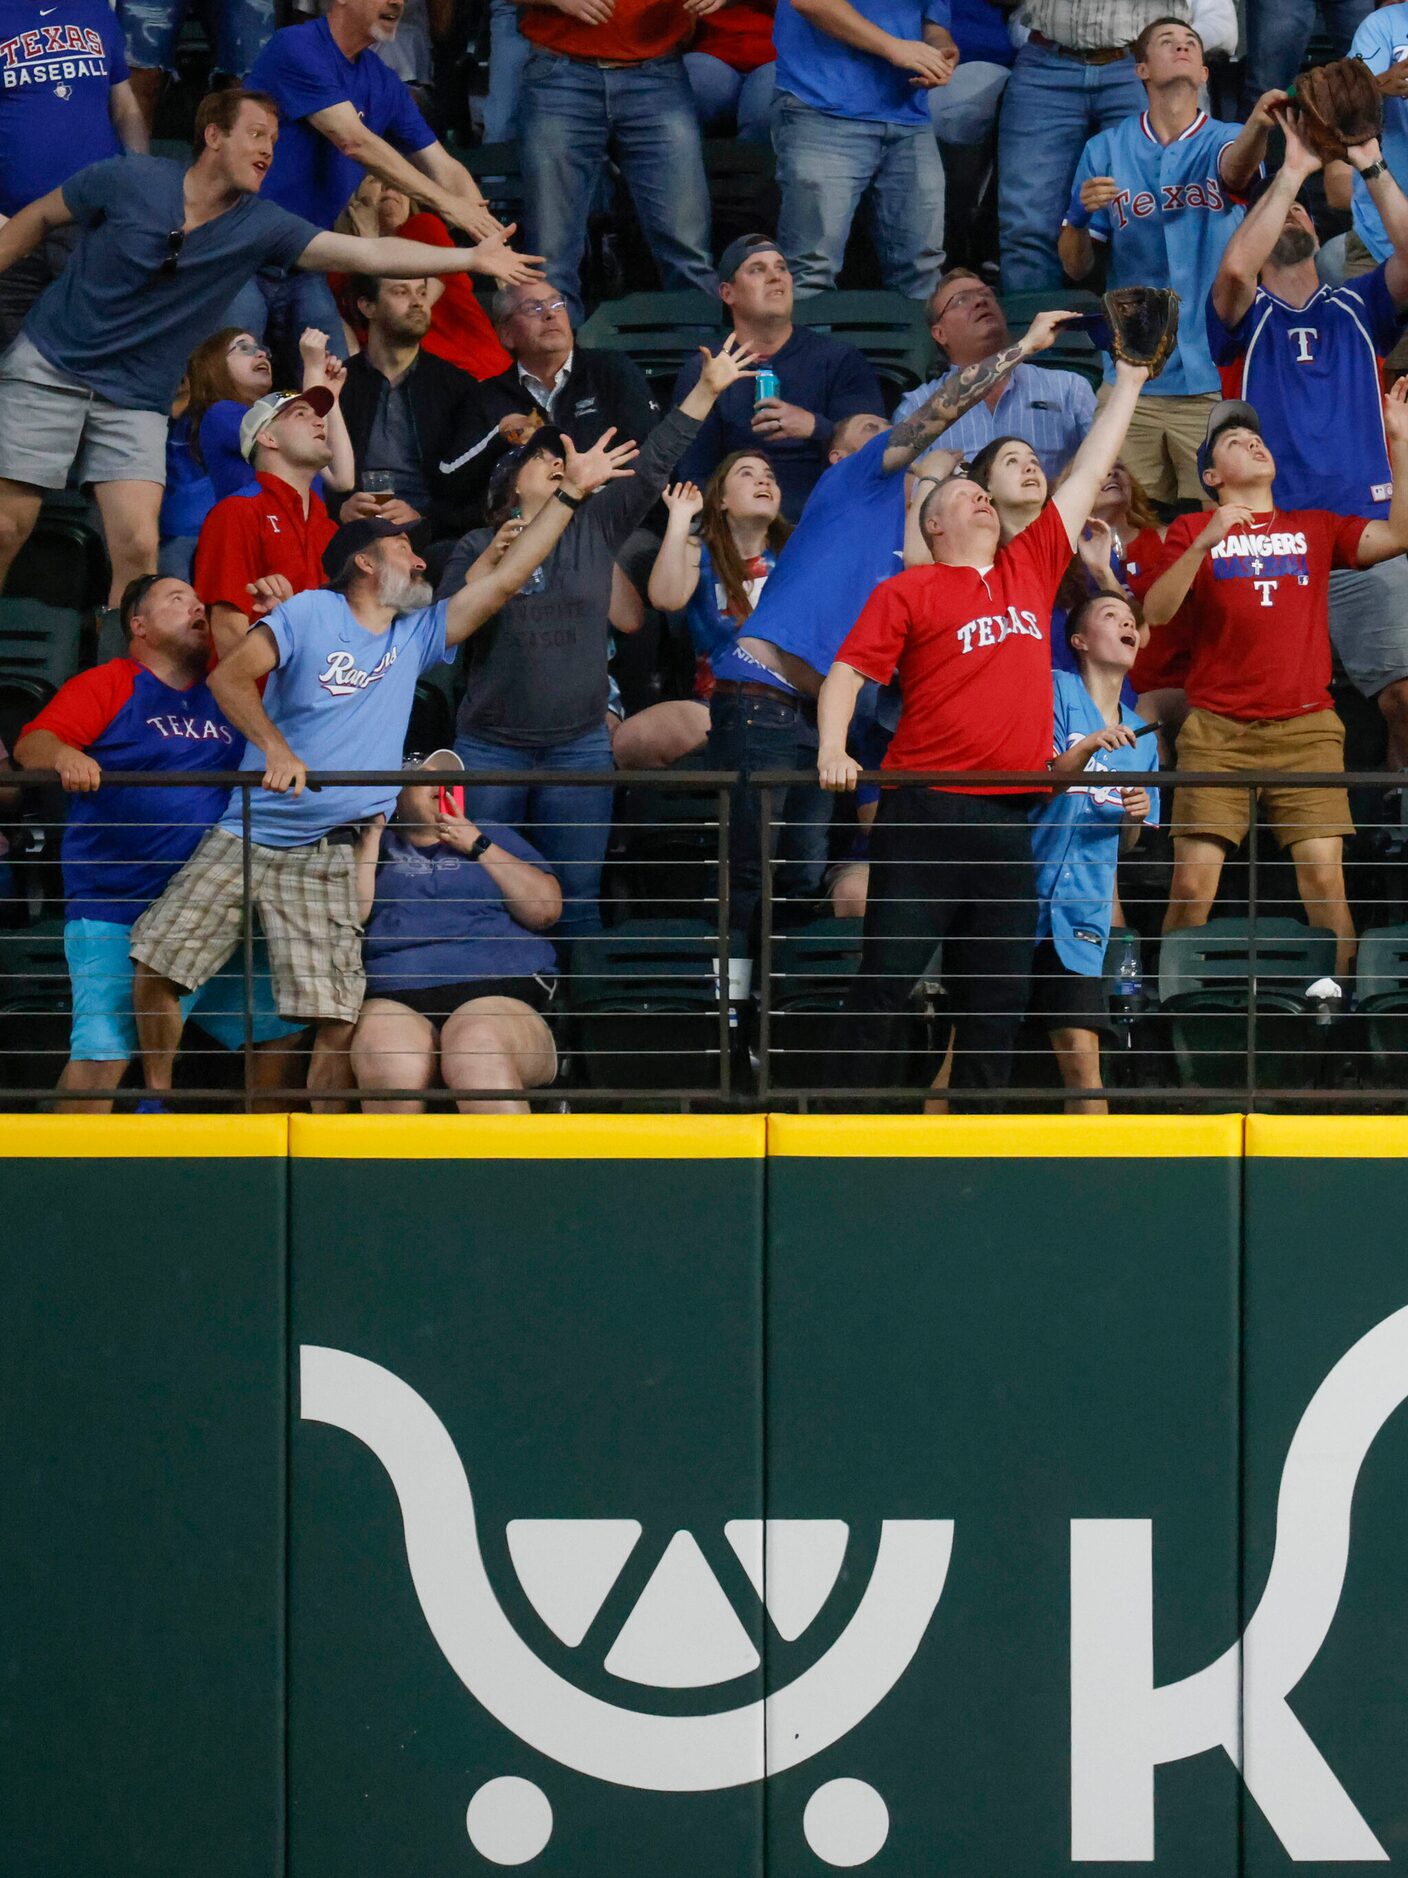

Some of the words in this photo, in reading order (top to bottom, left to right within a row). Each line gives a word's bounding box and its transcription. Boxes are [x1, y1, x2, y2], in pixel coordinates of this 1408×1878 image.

[0, 25, 104, 67] TEXAS
[3, 60, 108, 88] BASEBALL
[1111, 177, 1225, 230] Texas
[1287, 327, 1318, 364] T
[1211, 532, 1308, 559] RANGERS
[1213, 554, 1309, 581] BASBALL
[1253, 580, 1278, 607] T
[957, 606, 1043, 654] TEXAS
[146, 715, 232, 745] TEXAS
